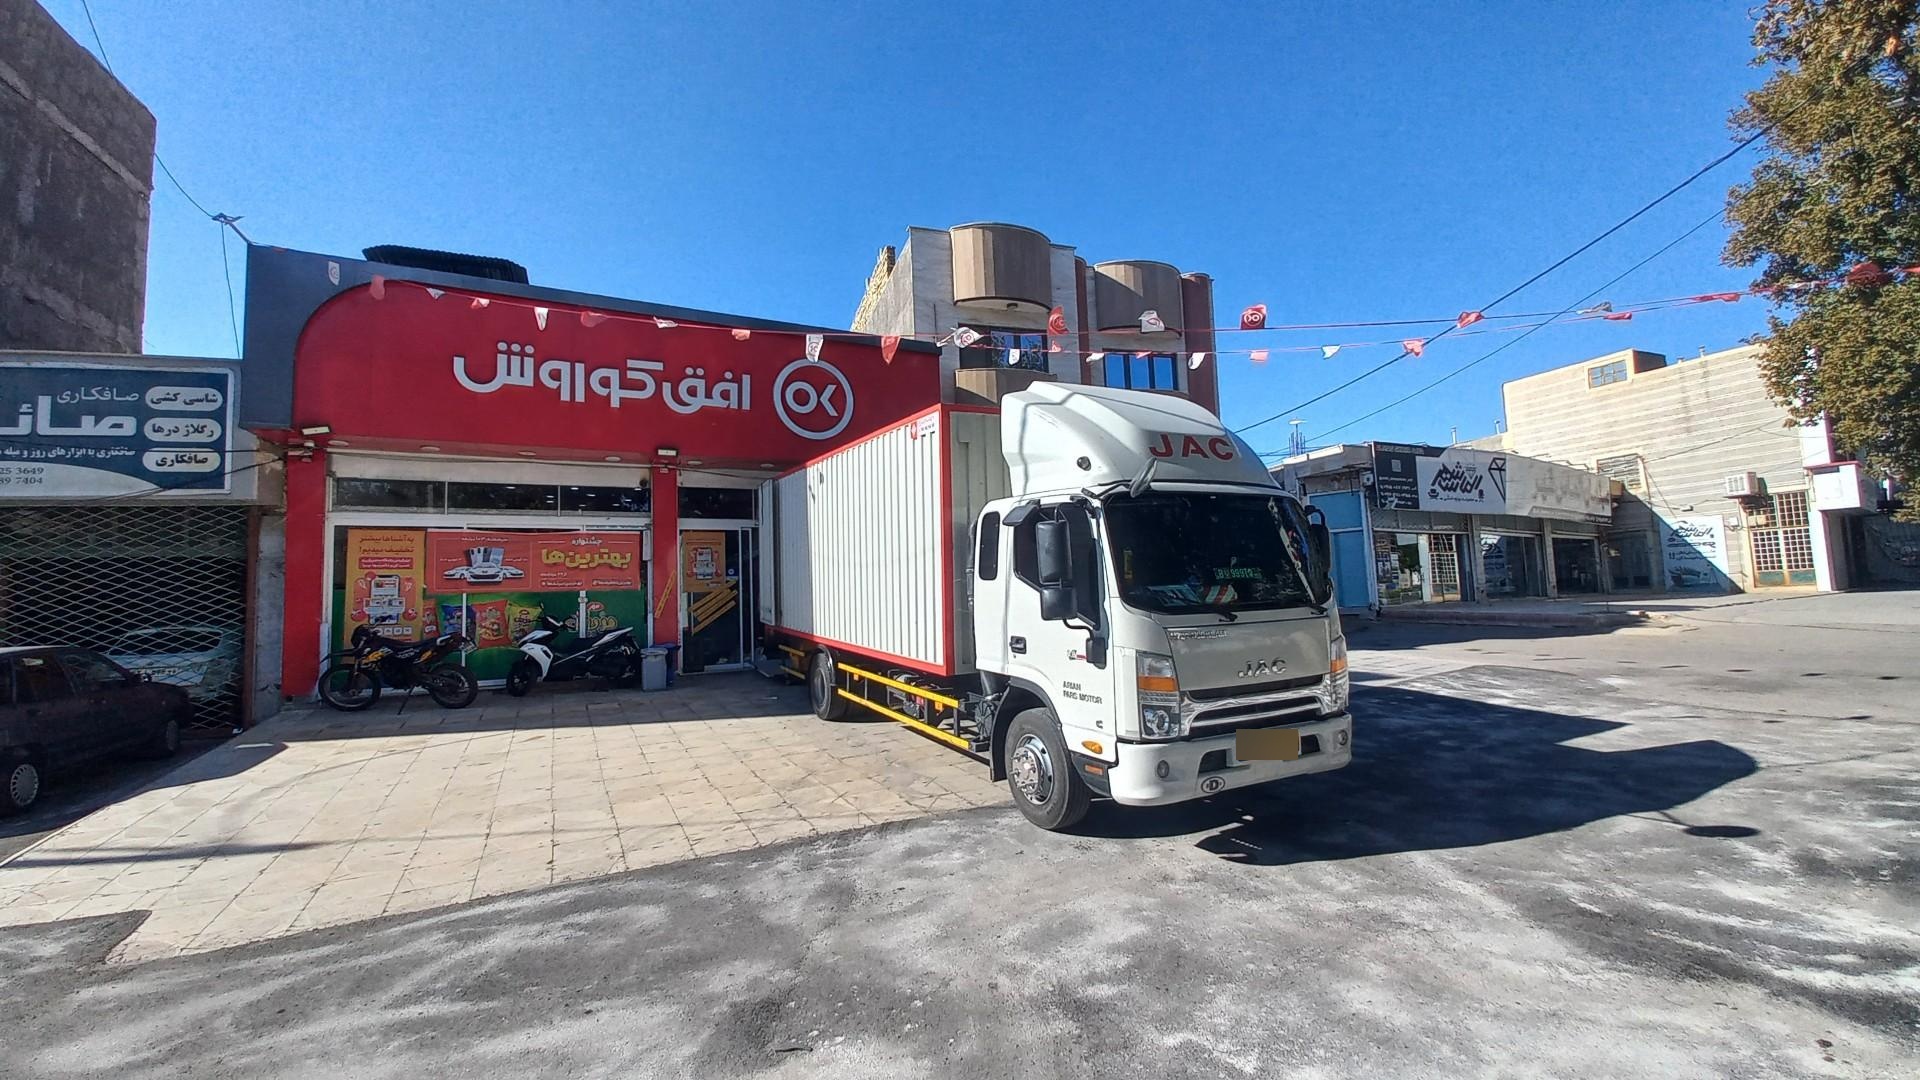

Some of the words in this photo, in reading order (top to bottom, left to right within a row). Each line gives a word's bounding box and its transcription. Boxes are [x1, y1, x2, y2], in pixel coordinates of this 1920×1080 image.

[453, 342, 664, 408] کوروش
[57, 387, 139, 404] صافکاری
[150, 391, 181, 404] کشی
[662, 367, 751, 414] افق
[183, 391, 219, 406] شاسی
[784, 382, 838, 417] OK
[0, 395, 138, 437] صائ
[152, 423, 180, 435] درها
[184, 423, 215, 438] رگلاژ
[22, 449, 28, 458] و
[29, 448, 46, 458] روز
[1149, 433, 1234, 461] JAC
[156, 452, 209, 467] صافکاری
[15, 467, 44, 475] 3649
[15, 477, 43, 485] 7404
[571, 535, 603, 546] جشنواره
[1238, 657, 1287, 678] JAC
[1079, 692, 1103, 705] MOTOR
